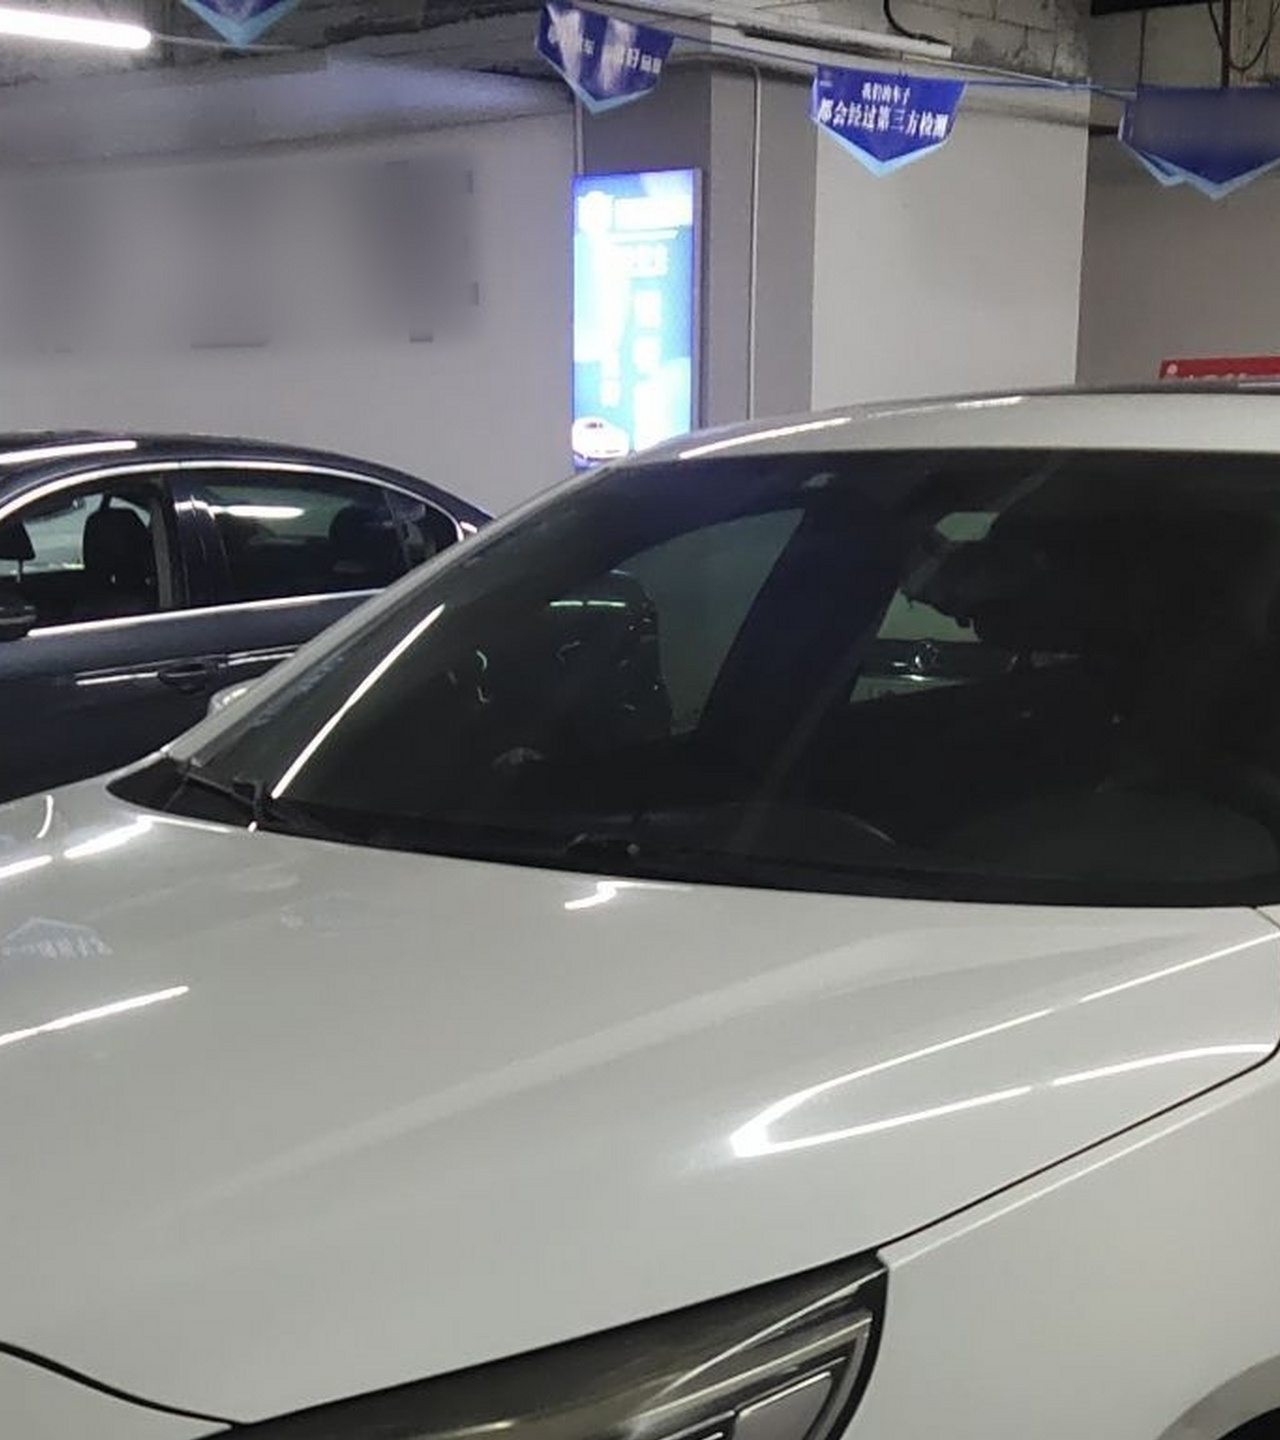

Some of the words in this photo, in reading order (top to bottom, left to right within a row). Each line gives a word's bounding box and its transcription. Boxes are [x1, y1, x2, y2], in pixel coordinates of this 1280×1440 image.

[820, 97, 949, 138] 都会经过第三方检测
